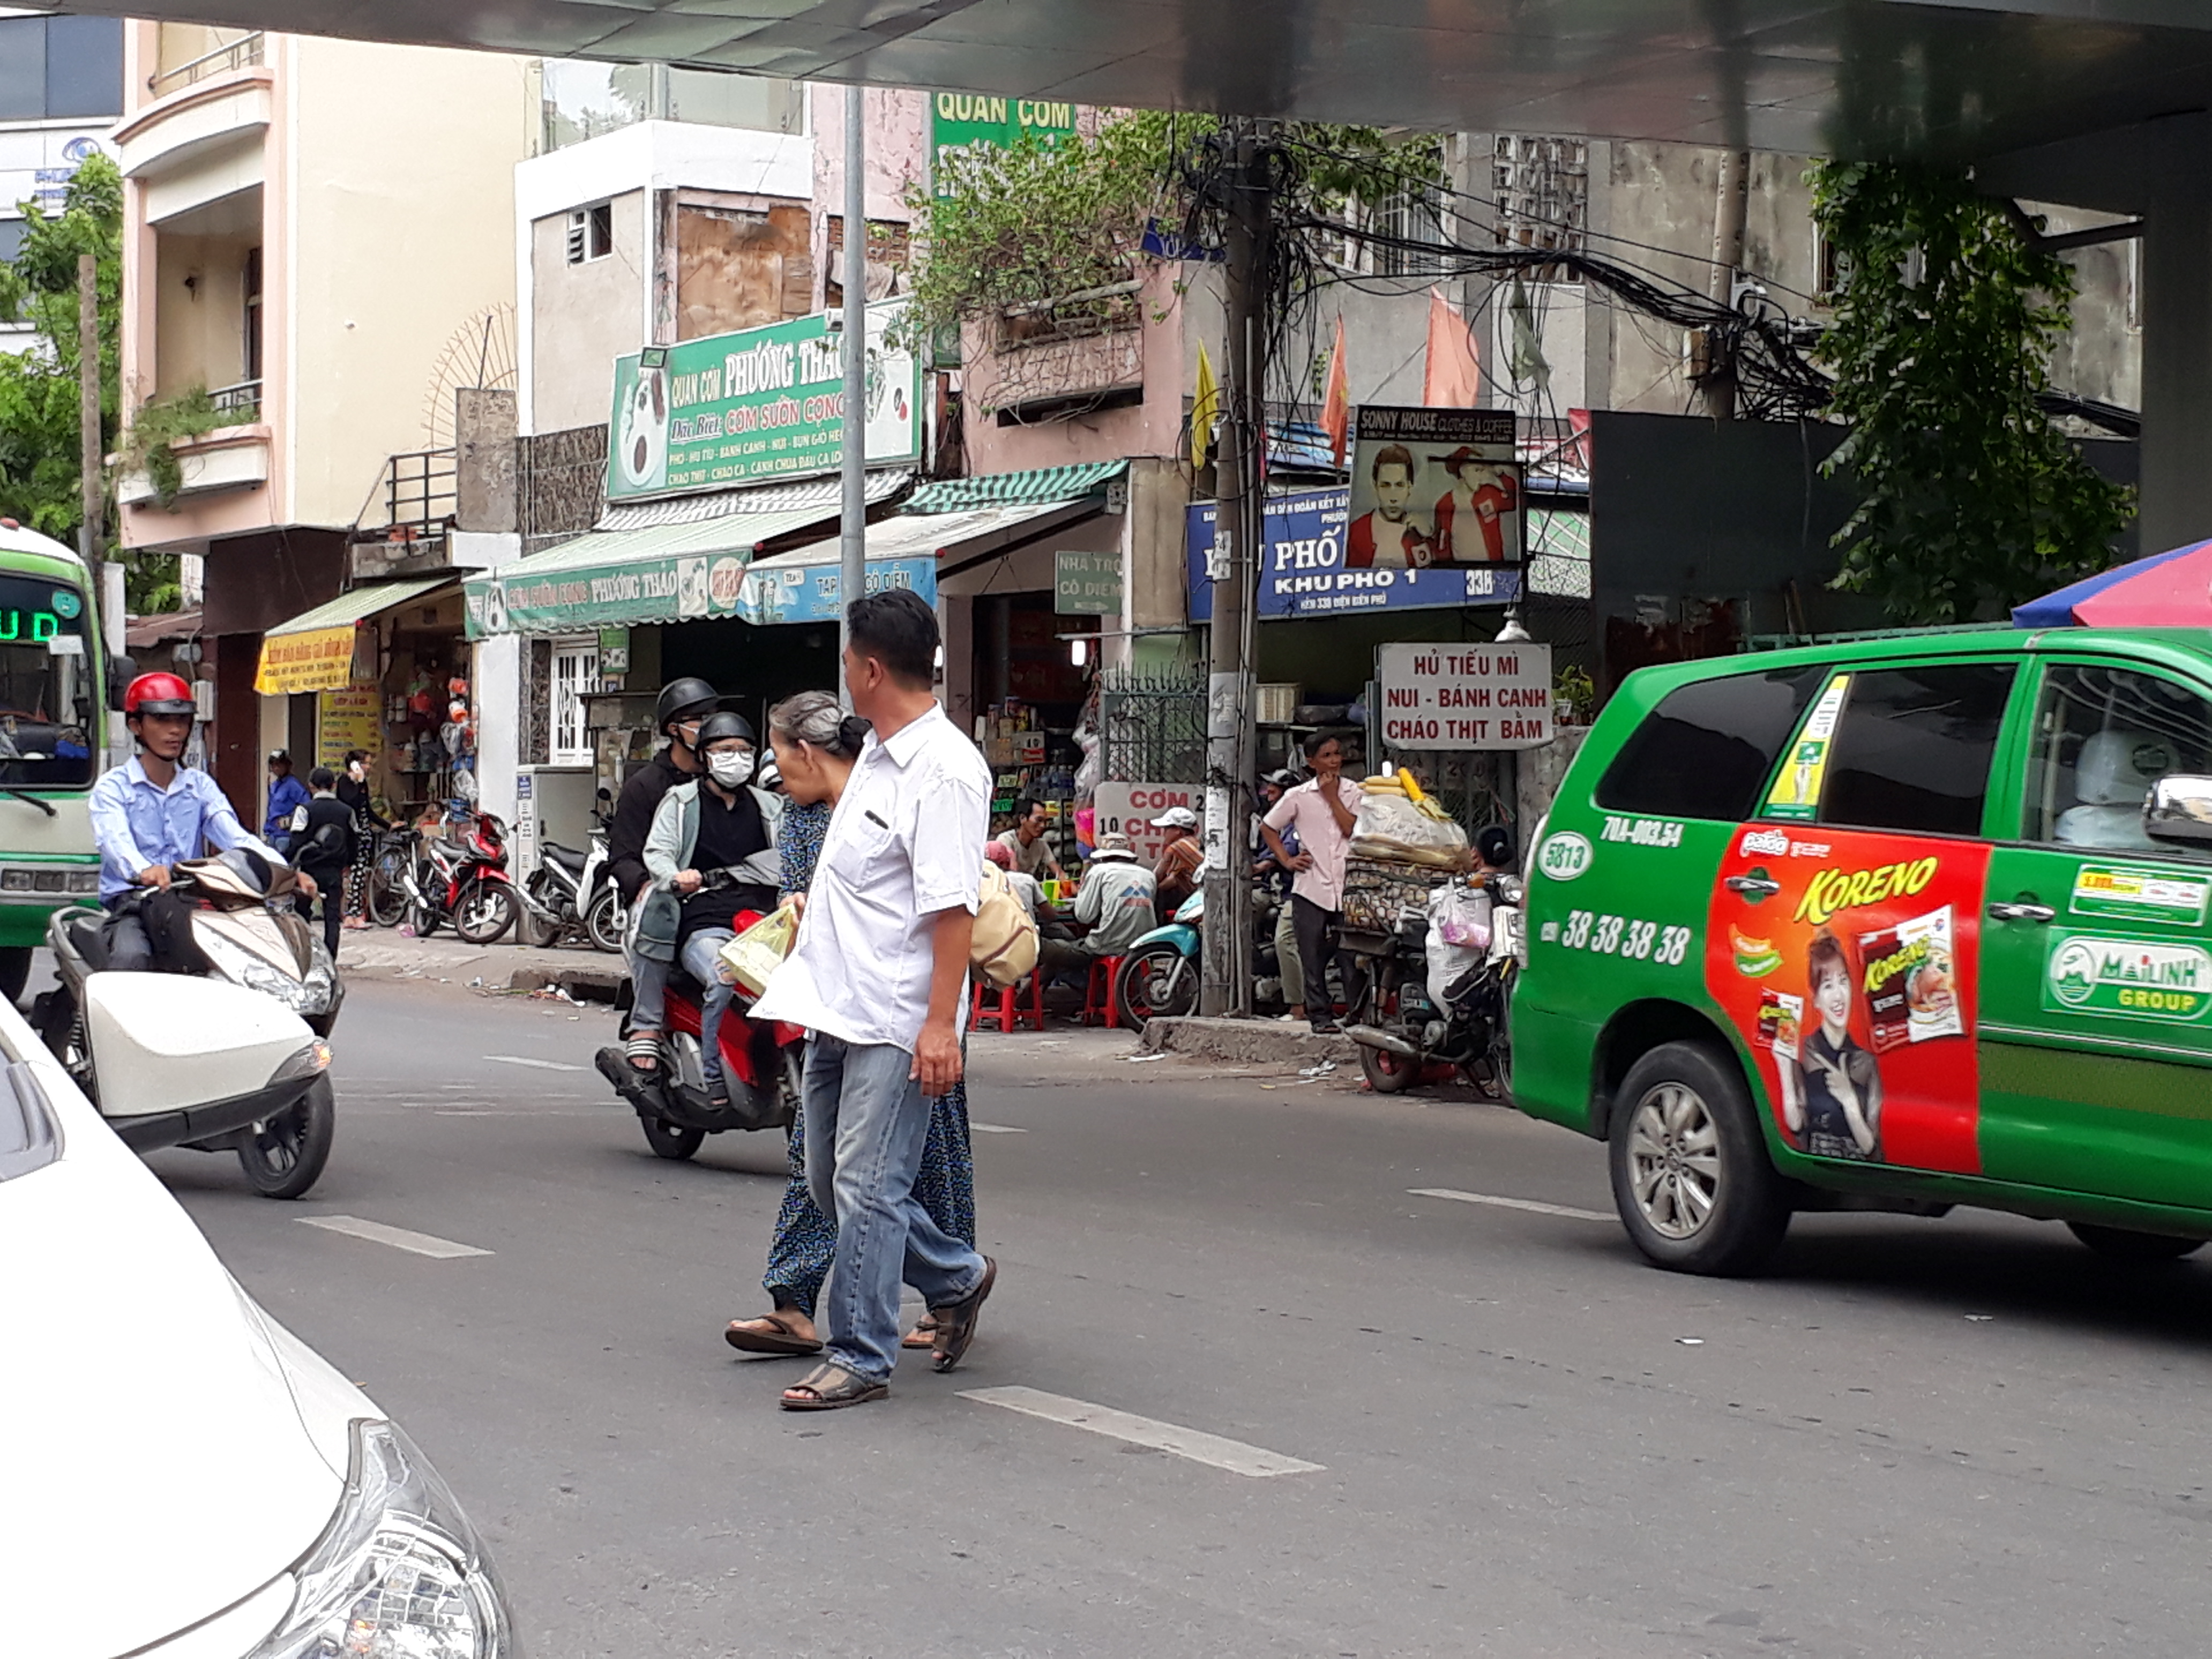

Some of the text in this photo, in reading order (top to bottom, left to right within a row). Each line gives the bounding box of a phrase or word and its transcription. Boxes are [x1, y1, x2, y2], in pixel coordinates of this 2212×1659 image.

[1361, 410, 1399, 430] SONNY
[1400, 412, 1438, 431] HOUSE
[1274, 525, 1341, 571] PHỐ
[642, 562, 677, 597] THẢO
[1275, 575, 1332, 595] KHU
[1404, 569, 1416, 584] 1
[1414, 648, 1519, 675] HỦ TIẾU MÌ
[1387, 689, 1419, 708] NUI
[1439, 683, 1491, 708] BÁNH
[1497, 689, 1546, 708] CANH
[1387, 713, 1439, 739] CHÁO
[1445, 720, 1489, 744] THỊT
[1130, 788, 1189, 809] CƠM
[1562, 909, 1691, 966] 38 38 38 38
[2119, 989, 2195, 1011] GROUP
